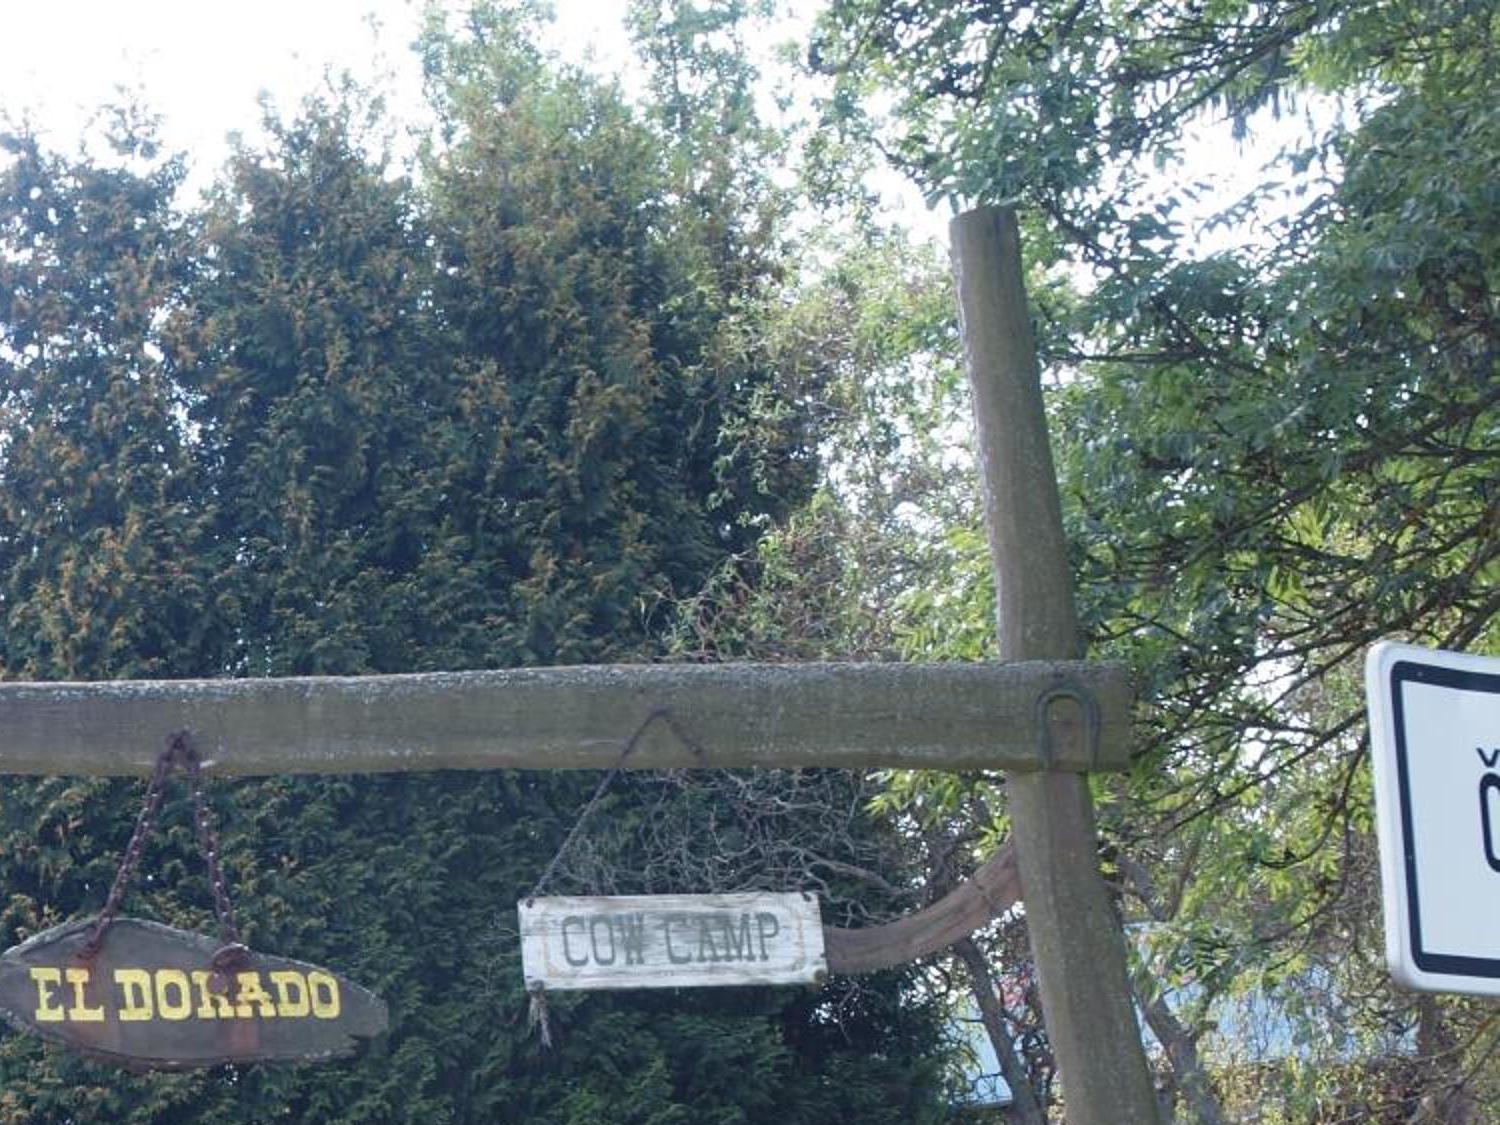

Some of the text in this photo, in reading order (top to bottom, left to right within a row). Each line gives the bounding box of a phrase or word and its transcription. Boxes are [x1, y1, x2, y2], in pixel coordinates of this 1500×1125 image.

[561, 911, 781, 967] COW CAMP
[29, 967, 342, 1022] EL DORADO
